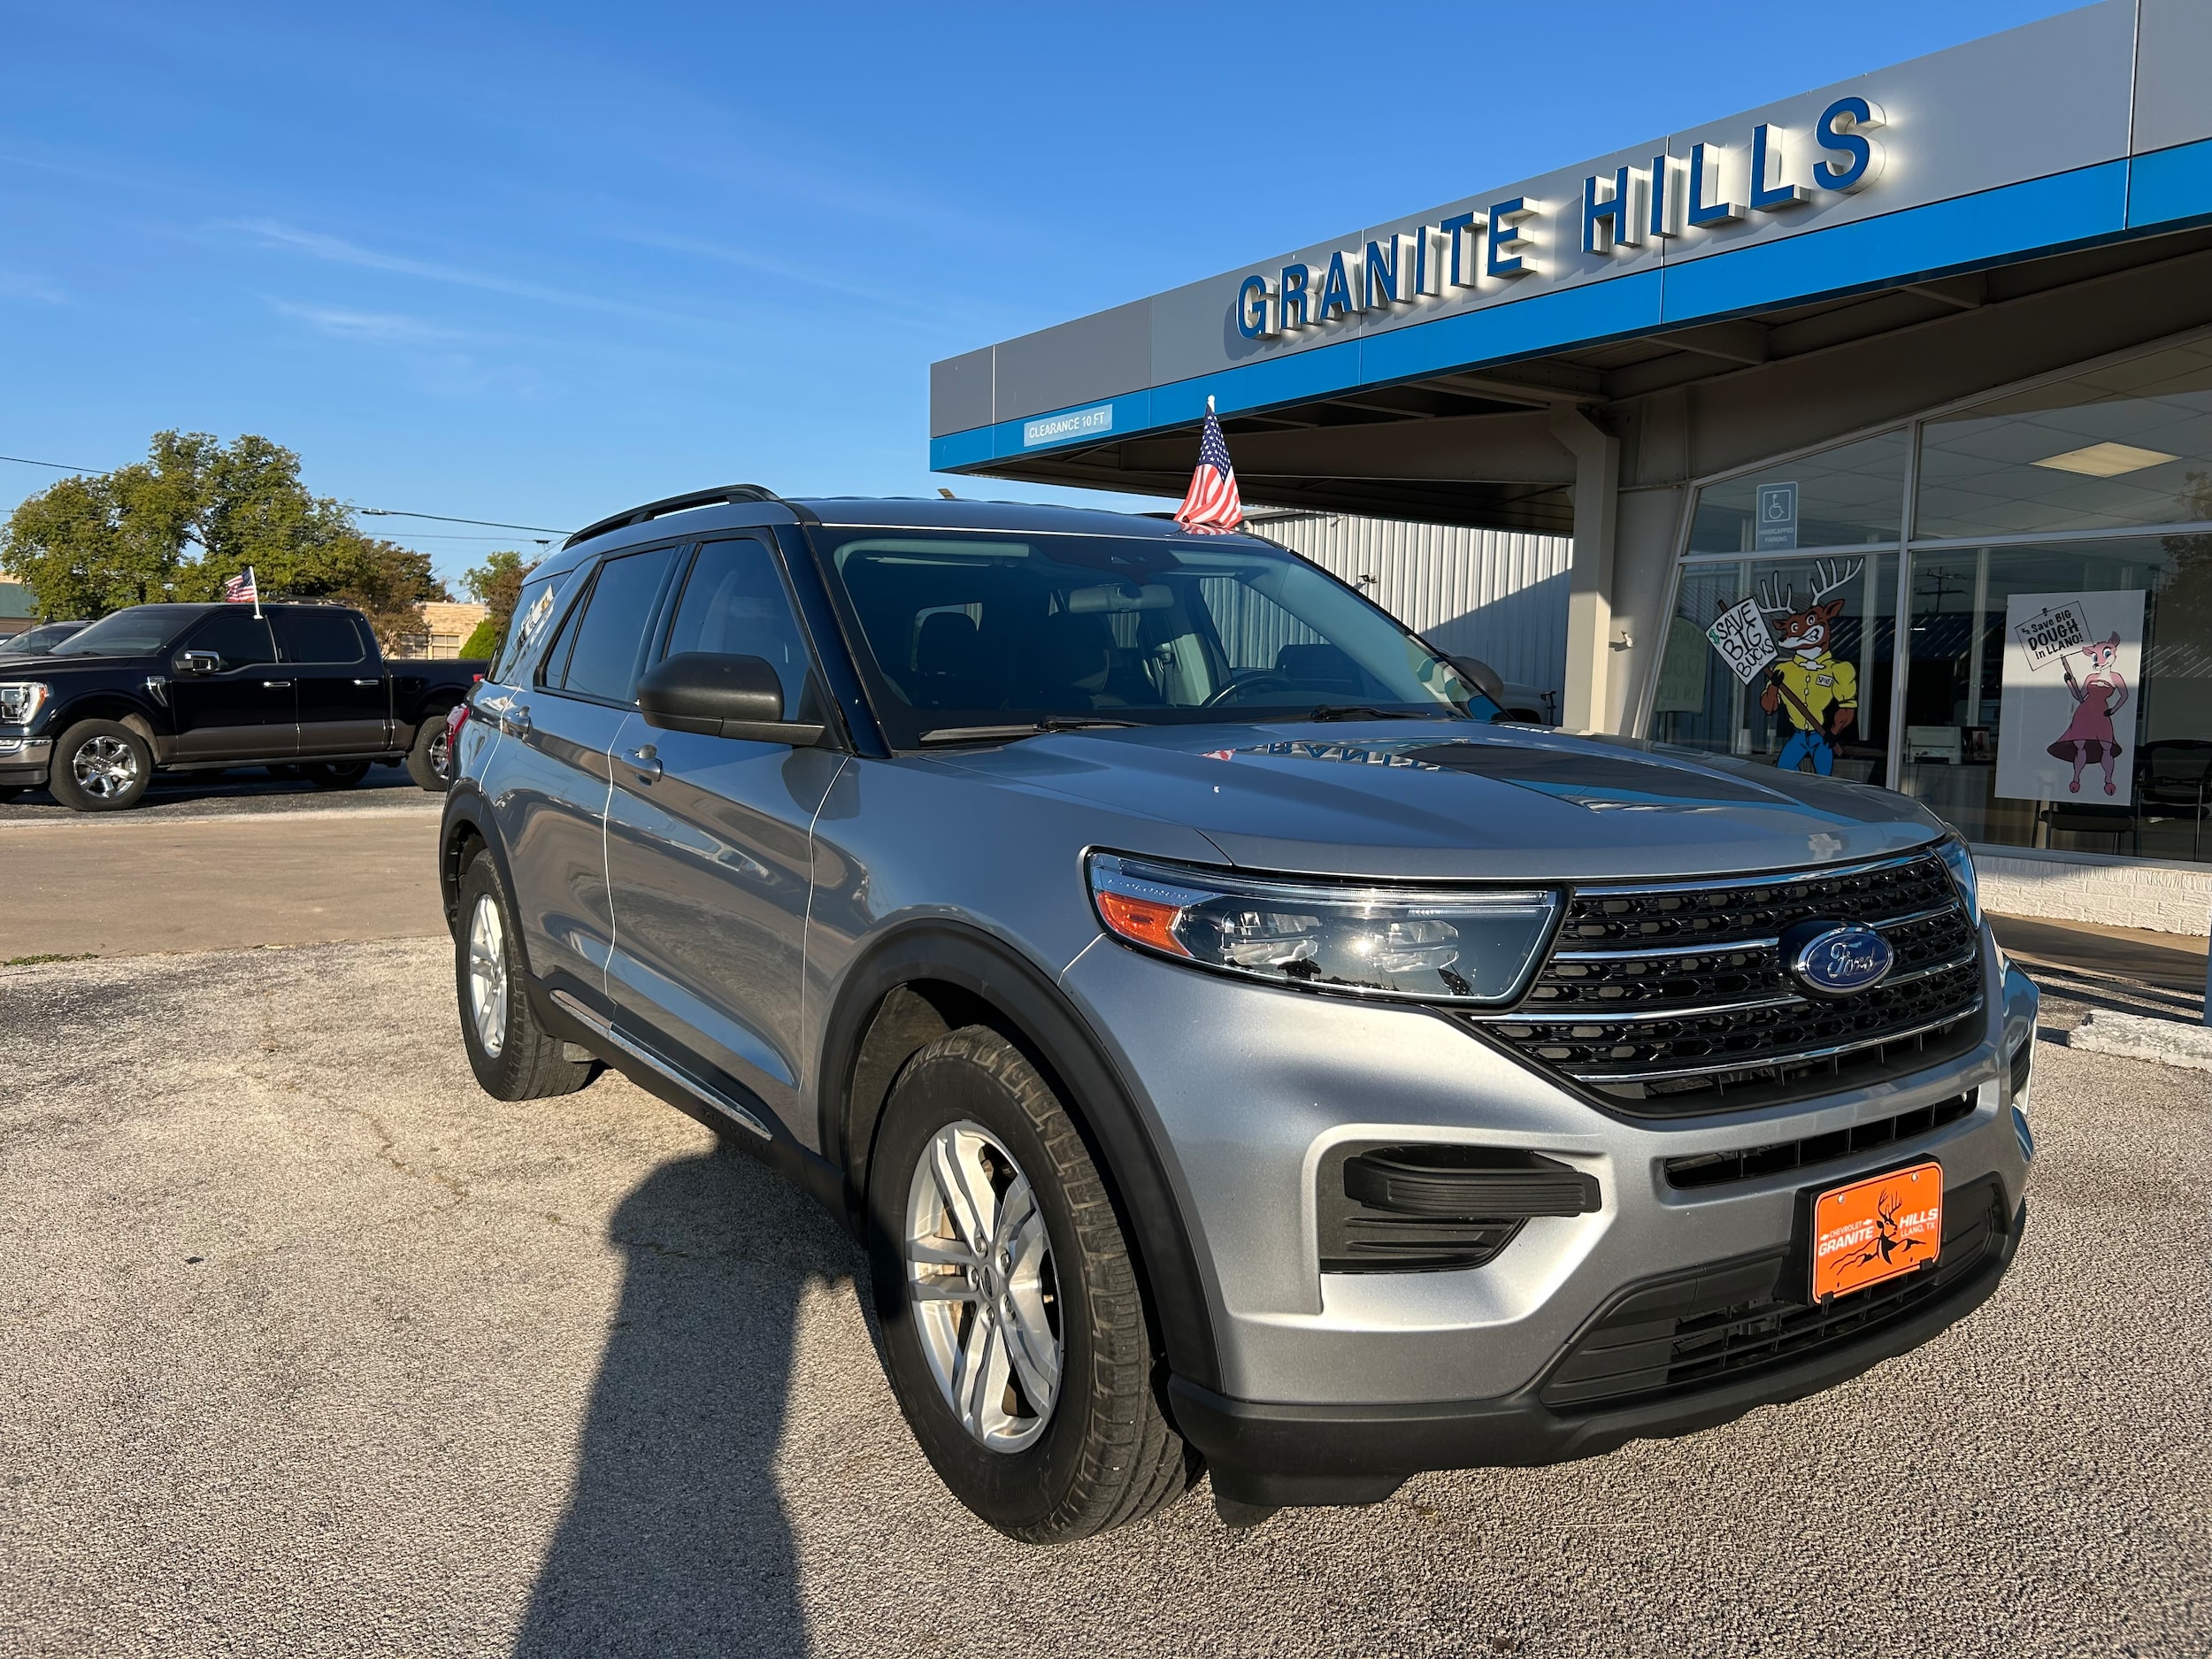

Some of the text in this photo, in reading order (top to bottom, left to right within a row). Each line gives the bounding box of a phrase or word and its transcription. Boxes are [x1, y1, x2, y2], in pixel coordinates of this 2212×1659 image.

[1235, 96, 1886, 340] GRANITE HILLS
[1029, 411, 1105, 439] CLEARANCE 10 FT
[1717, 603, 1756, 639] SAVE
[2027, 618, 2079, 650] DOUGH
[2031, 610, 2071, 633] Save BIG
[1723, 624, 1762, 661] BIG
[1736, 638, 1774, 677] BUCKS
[2046, 633, 2084, 655] LLANO!
[1827, 941, 1878, 979] Ford
[1818, 1208, 1939, 1256] GRANITE HILLS
[1829, 1220, 1863, 1238] CHEVROLET
[1926, 1222, 1935, 1231] TX
